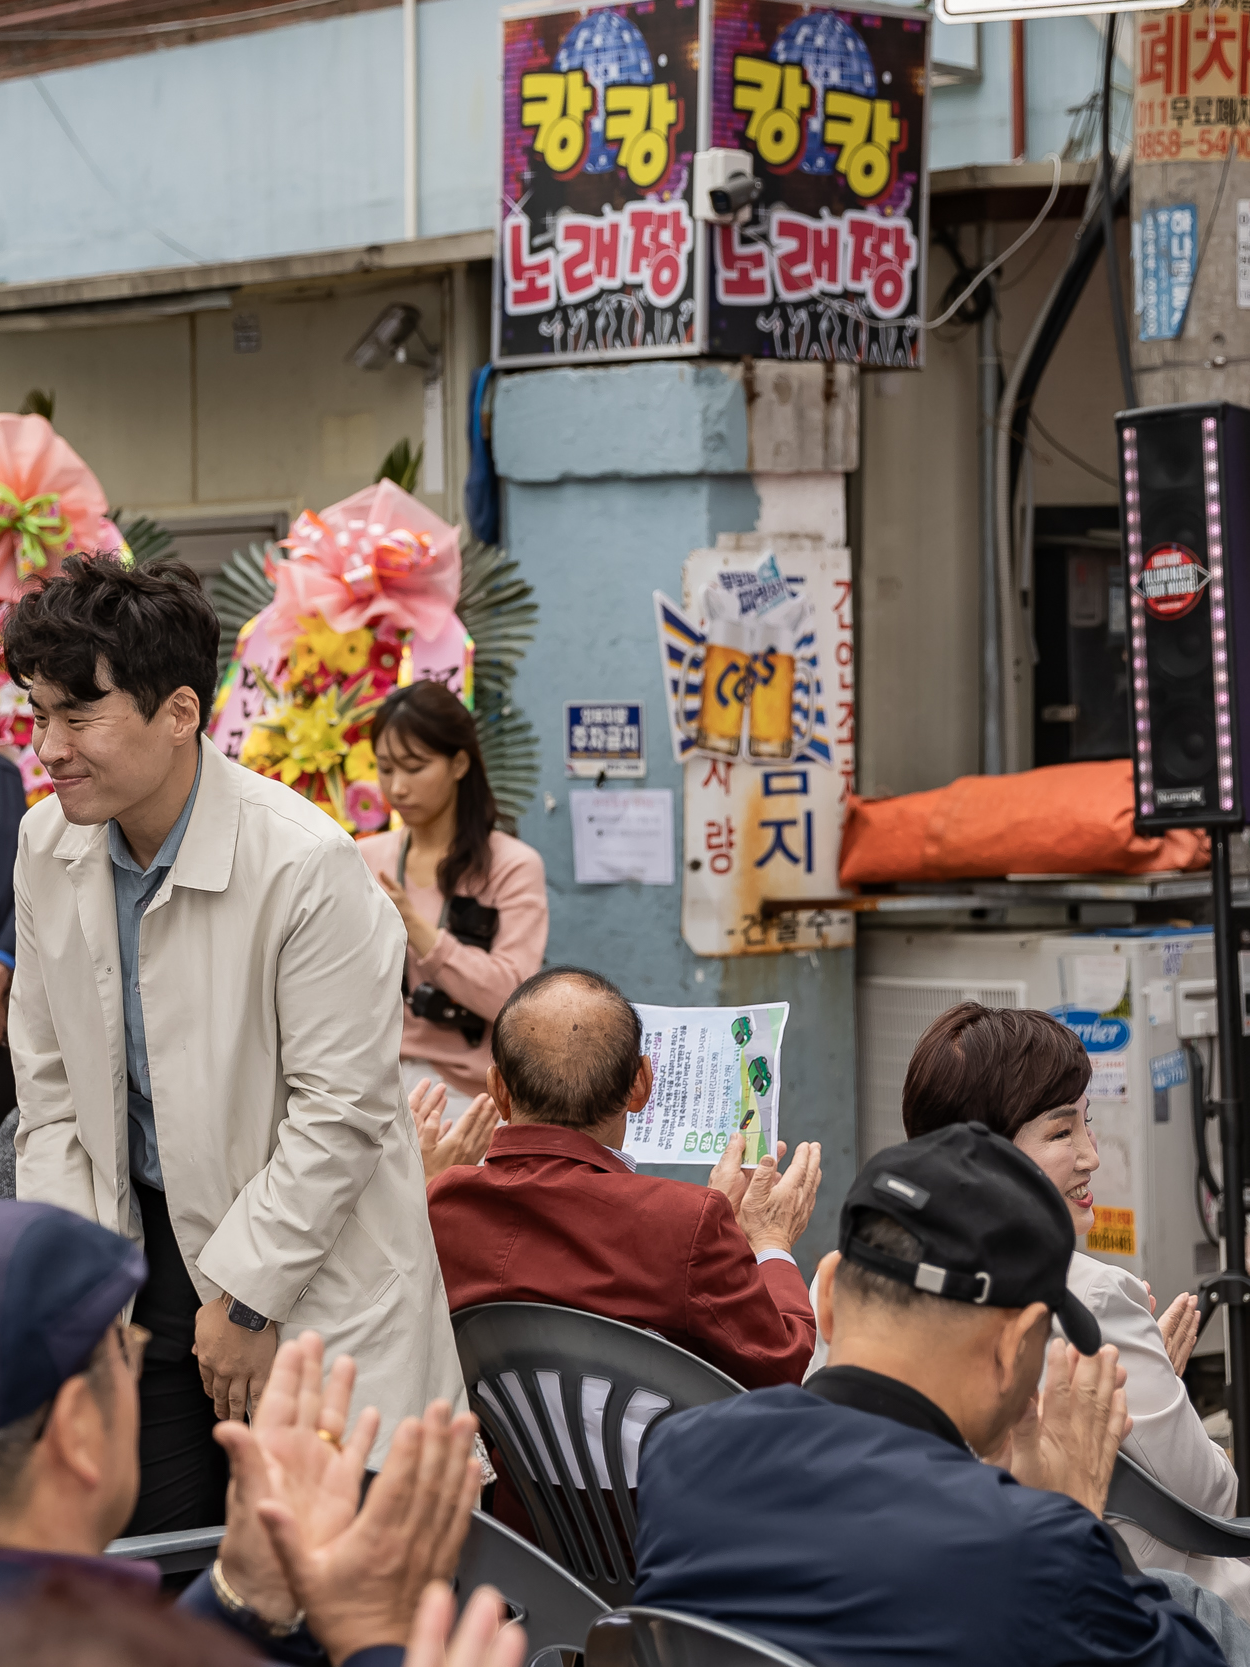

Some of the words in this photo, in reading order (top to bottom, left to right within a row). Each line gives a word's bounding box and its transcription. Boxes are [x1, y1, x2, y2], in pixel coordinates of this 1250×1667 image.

[521, 68, 678, 187] 캉캉
[733, 55, 901, 198] 캉캉
[507, 206, 690, 309] 노래짱
[684, 1135, 697, 1150] 일시
[700, 1135, 712, 1151] 장소
[715, 1136, 726, 1152] 추진
